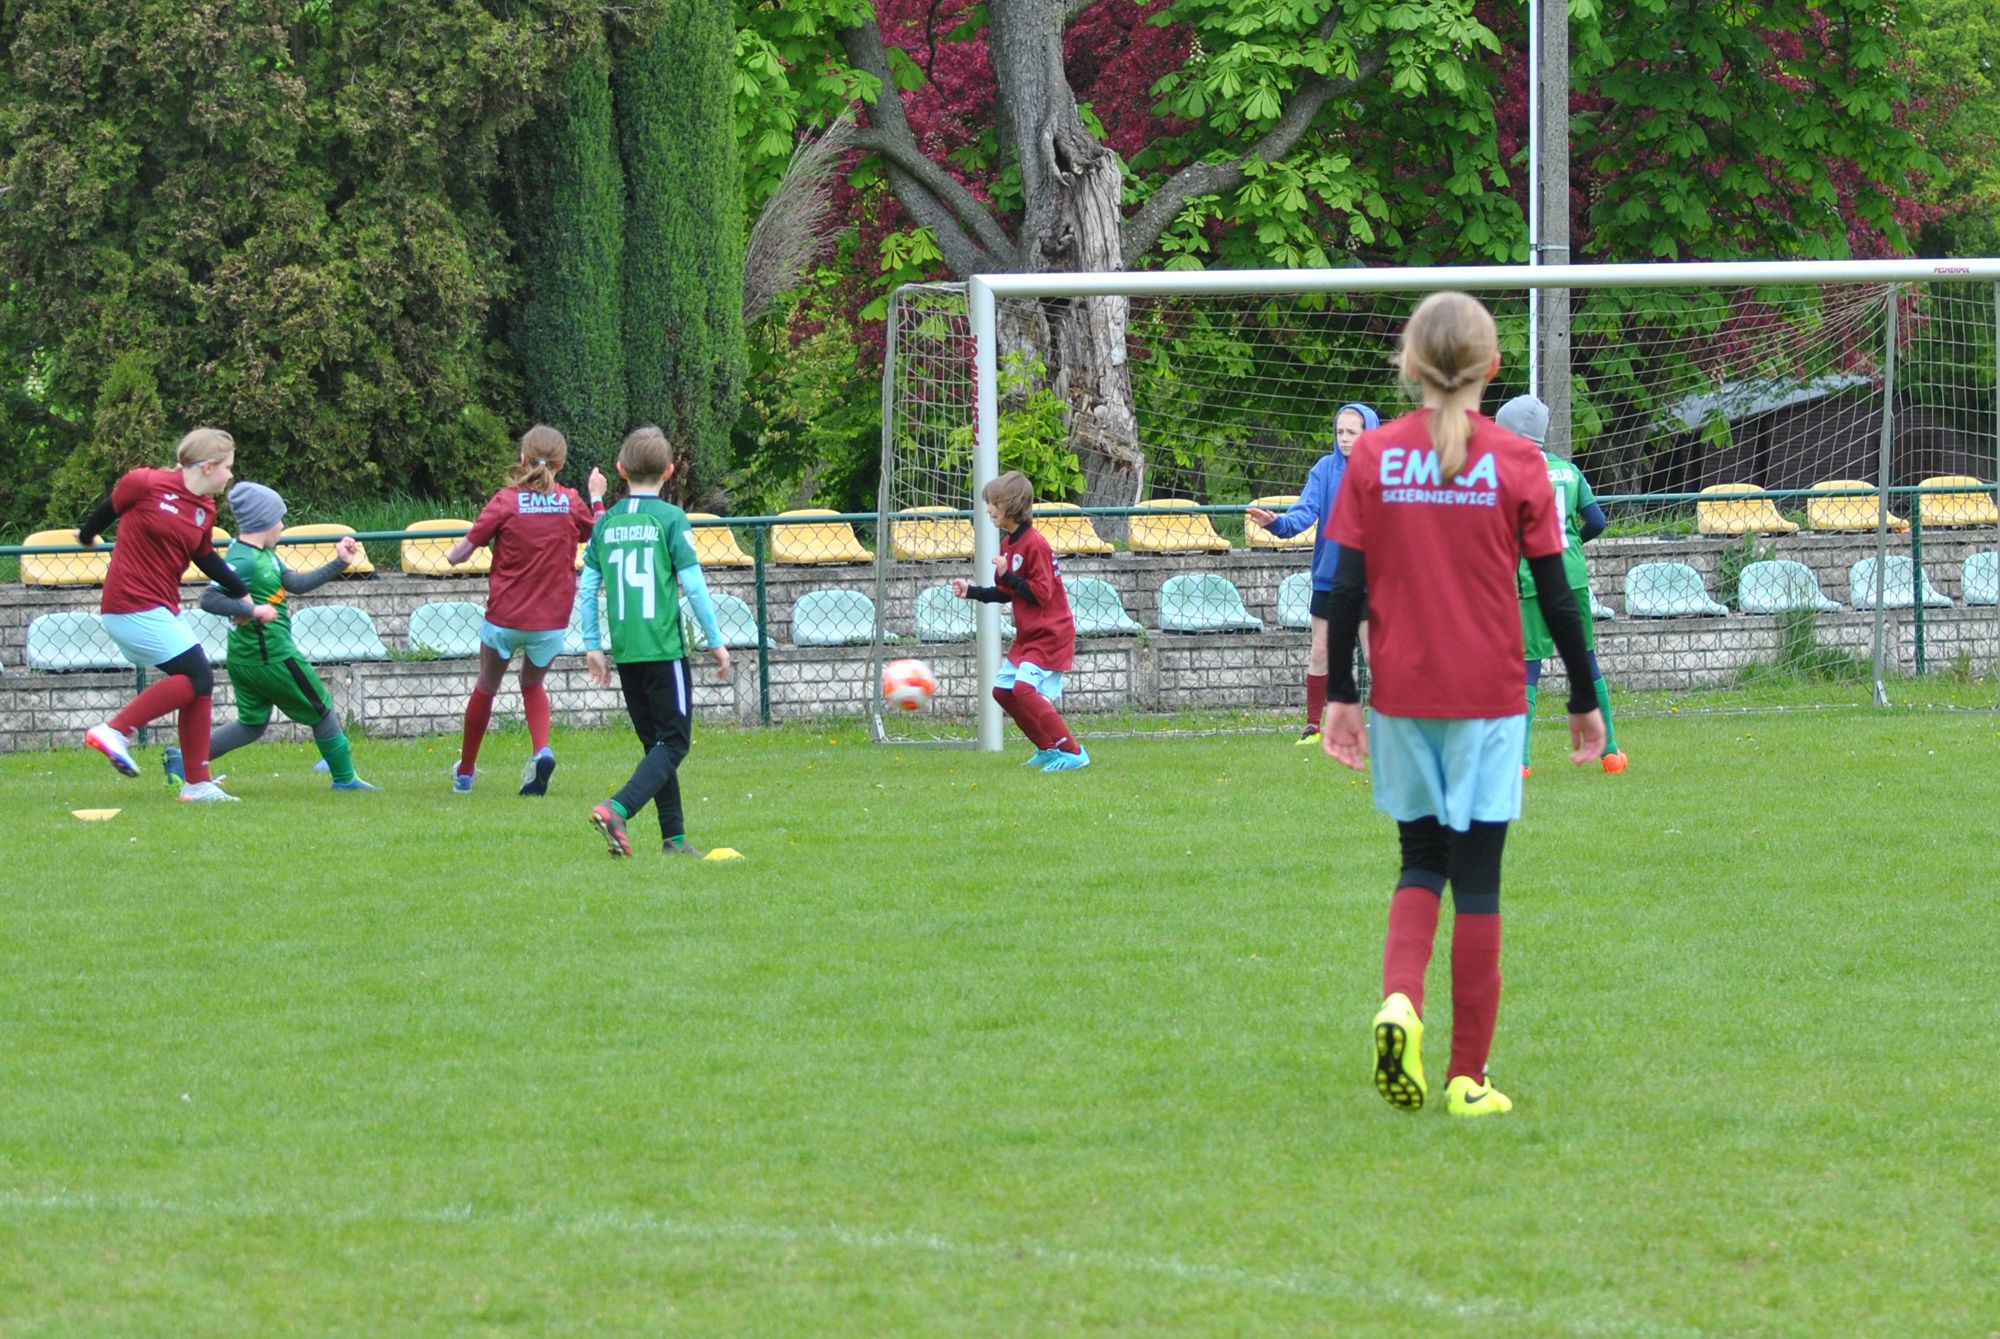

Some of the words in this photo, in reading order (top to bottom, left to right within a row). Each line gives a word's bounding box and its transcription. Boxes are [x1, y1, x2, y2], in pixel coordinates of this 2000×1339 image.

[1381, 448, 1498, 488] EMA
[518, 492, 569, 506] EMKA
[1382, 489, 1496, 506] SKIERNIEWICE
[608, 547, 655, 621] 14
